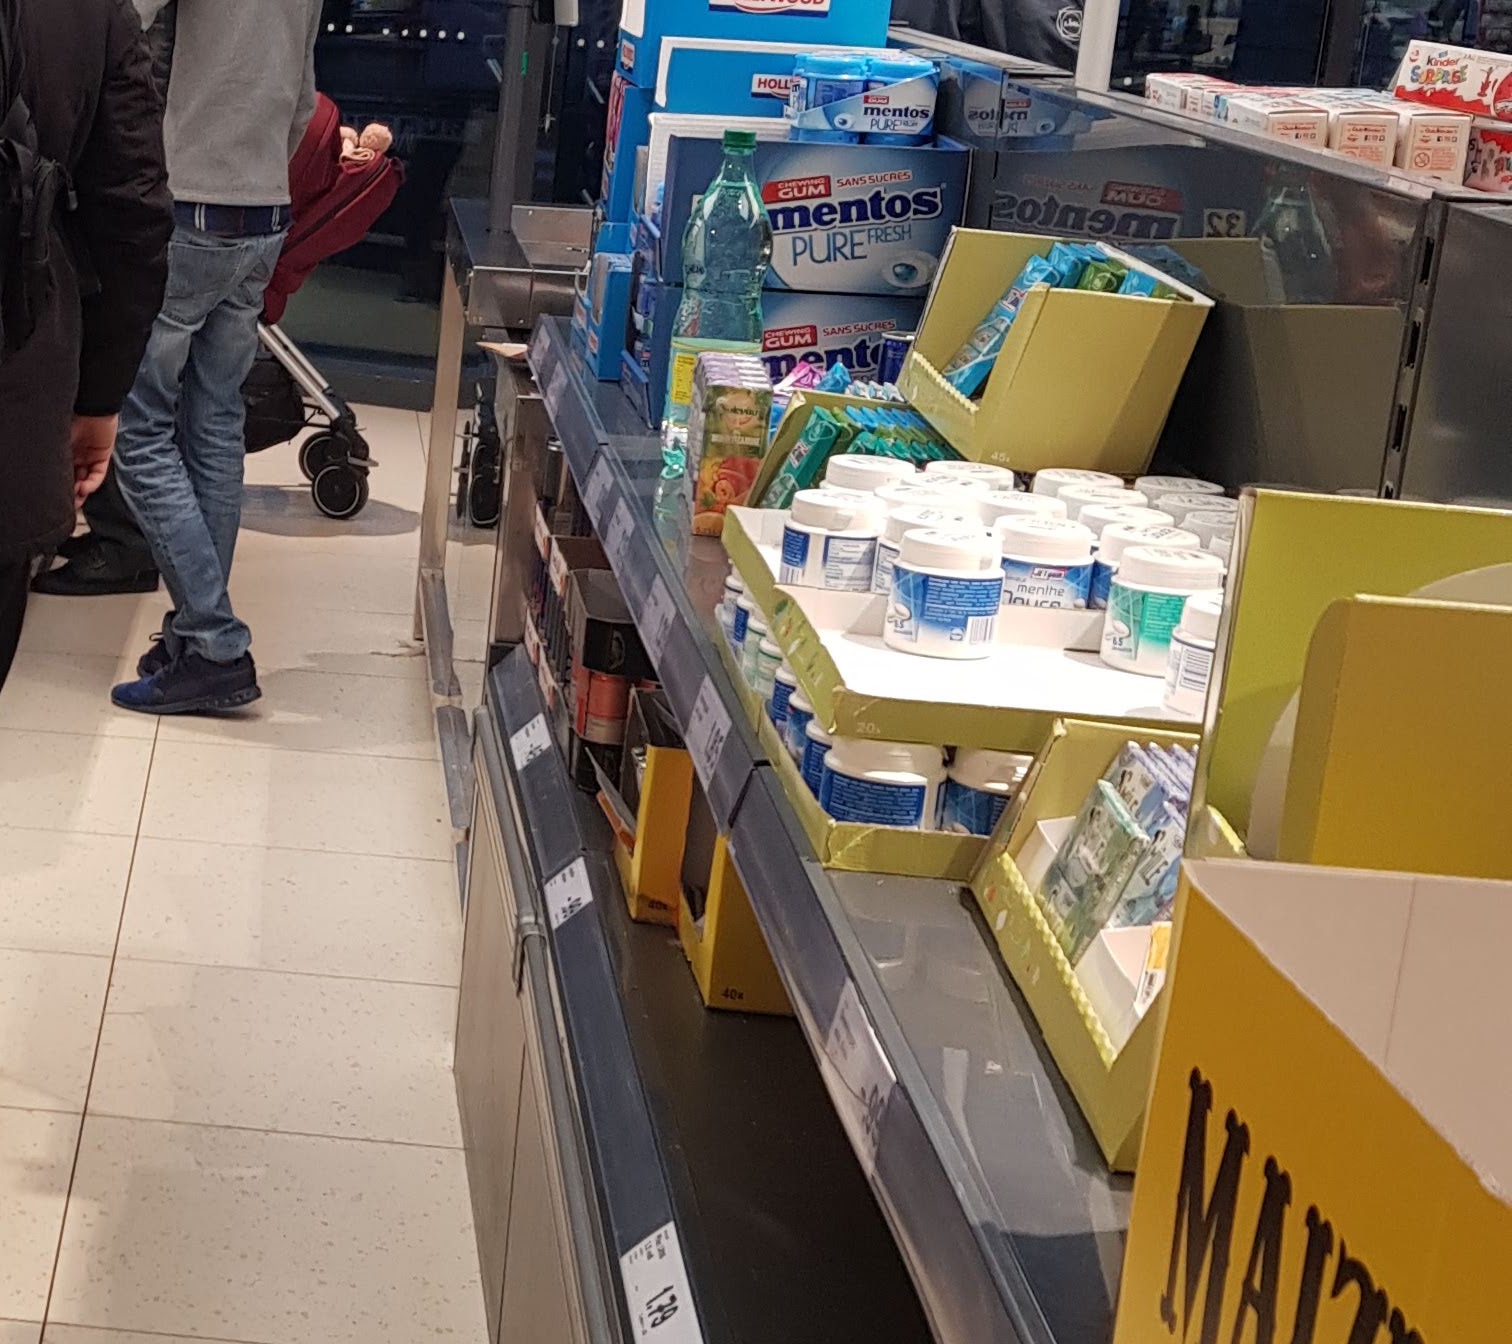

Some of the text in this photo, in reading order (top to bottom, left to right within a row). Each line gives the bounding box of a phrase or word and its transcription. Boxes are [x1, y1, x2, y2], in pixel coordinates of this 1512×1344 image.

[863, 106, 930, 119] mentos
[837, 171, 912, 187] SANS SUCRES
[778, 186, 826, 199] GUM
[769, 188, 941, 231] mentos
[792, 224, 912, 266] PURE FRESH
[765, 335, 813, 348] GUM
[762, 338, 882, 386] ment
[1017, 584, 1065, 598] menthe
[646, 1284, 679, 1329] 1.79
